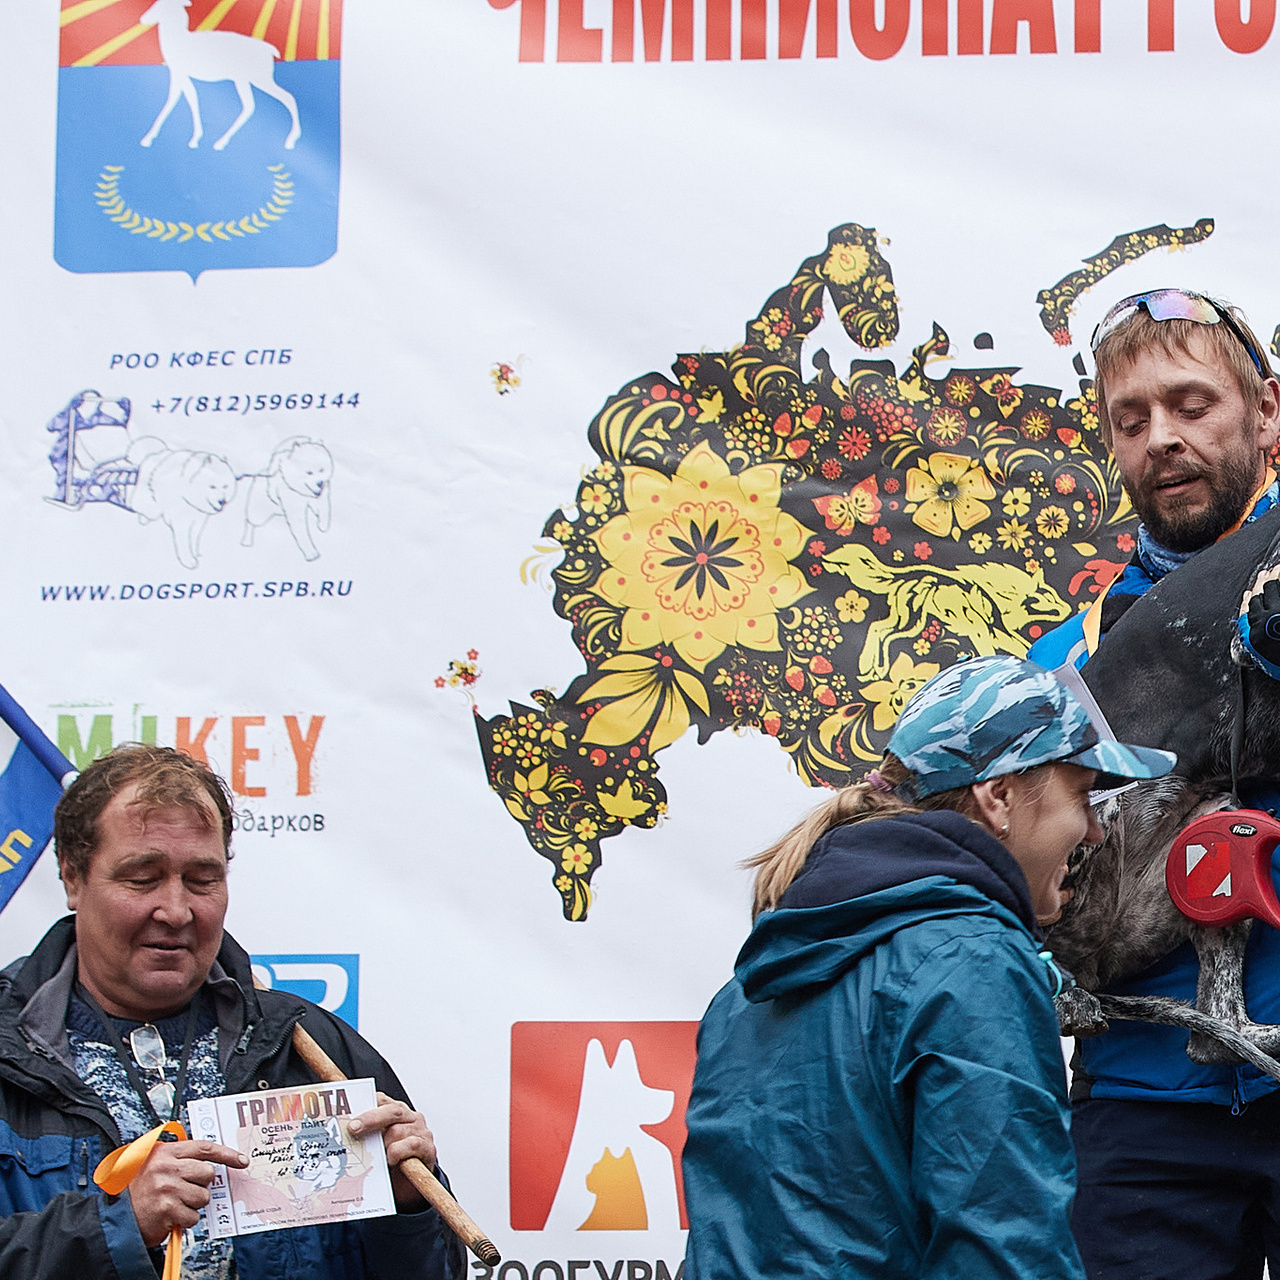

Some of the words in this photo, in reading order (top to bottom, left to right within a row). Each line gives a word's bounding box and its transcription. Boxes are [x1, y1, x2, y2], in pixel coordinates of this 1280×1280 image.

[110, 353, 159, 369] РОО
[170, 351, 235, 368] КФЕС
[245, 349, 293, 366] СПБ
[151, 393, 360, 416] +7(812)5969144
[41, 580, 353, 601] WWW.DOGSPORT.SPB.RU
[236, 1089, 351, 1127] ГРАМОТА
[261, 1124, 293, 1134] ОСЕНЬ
